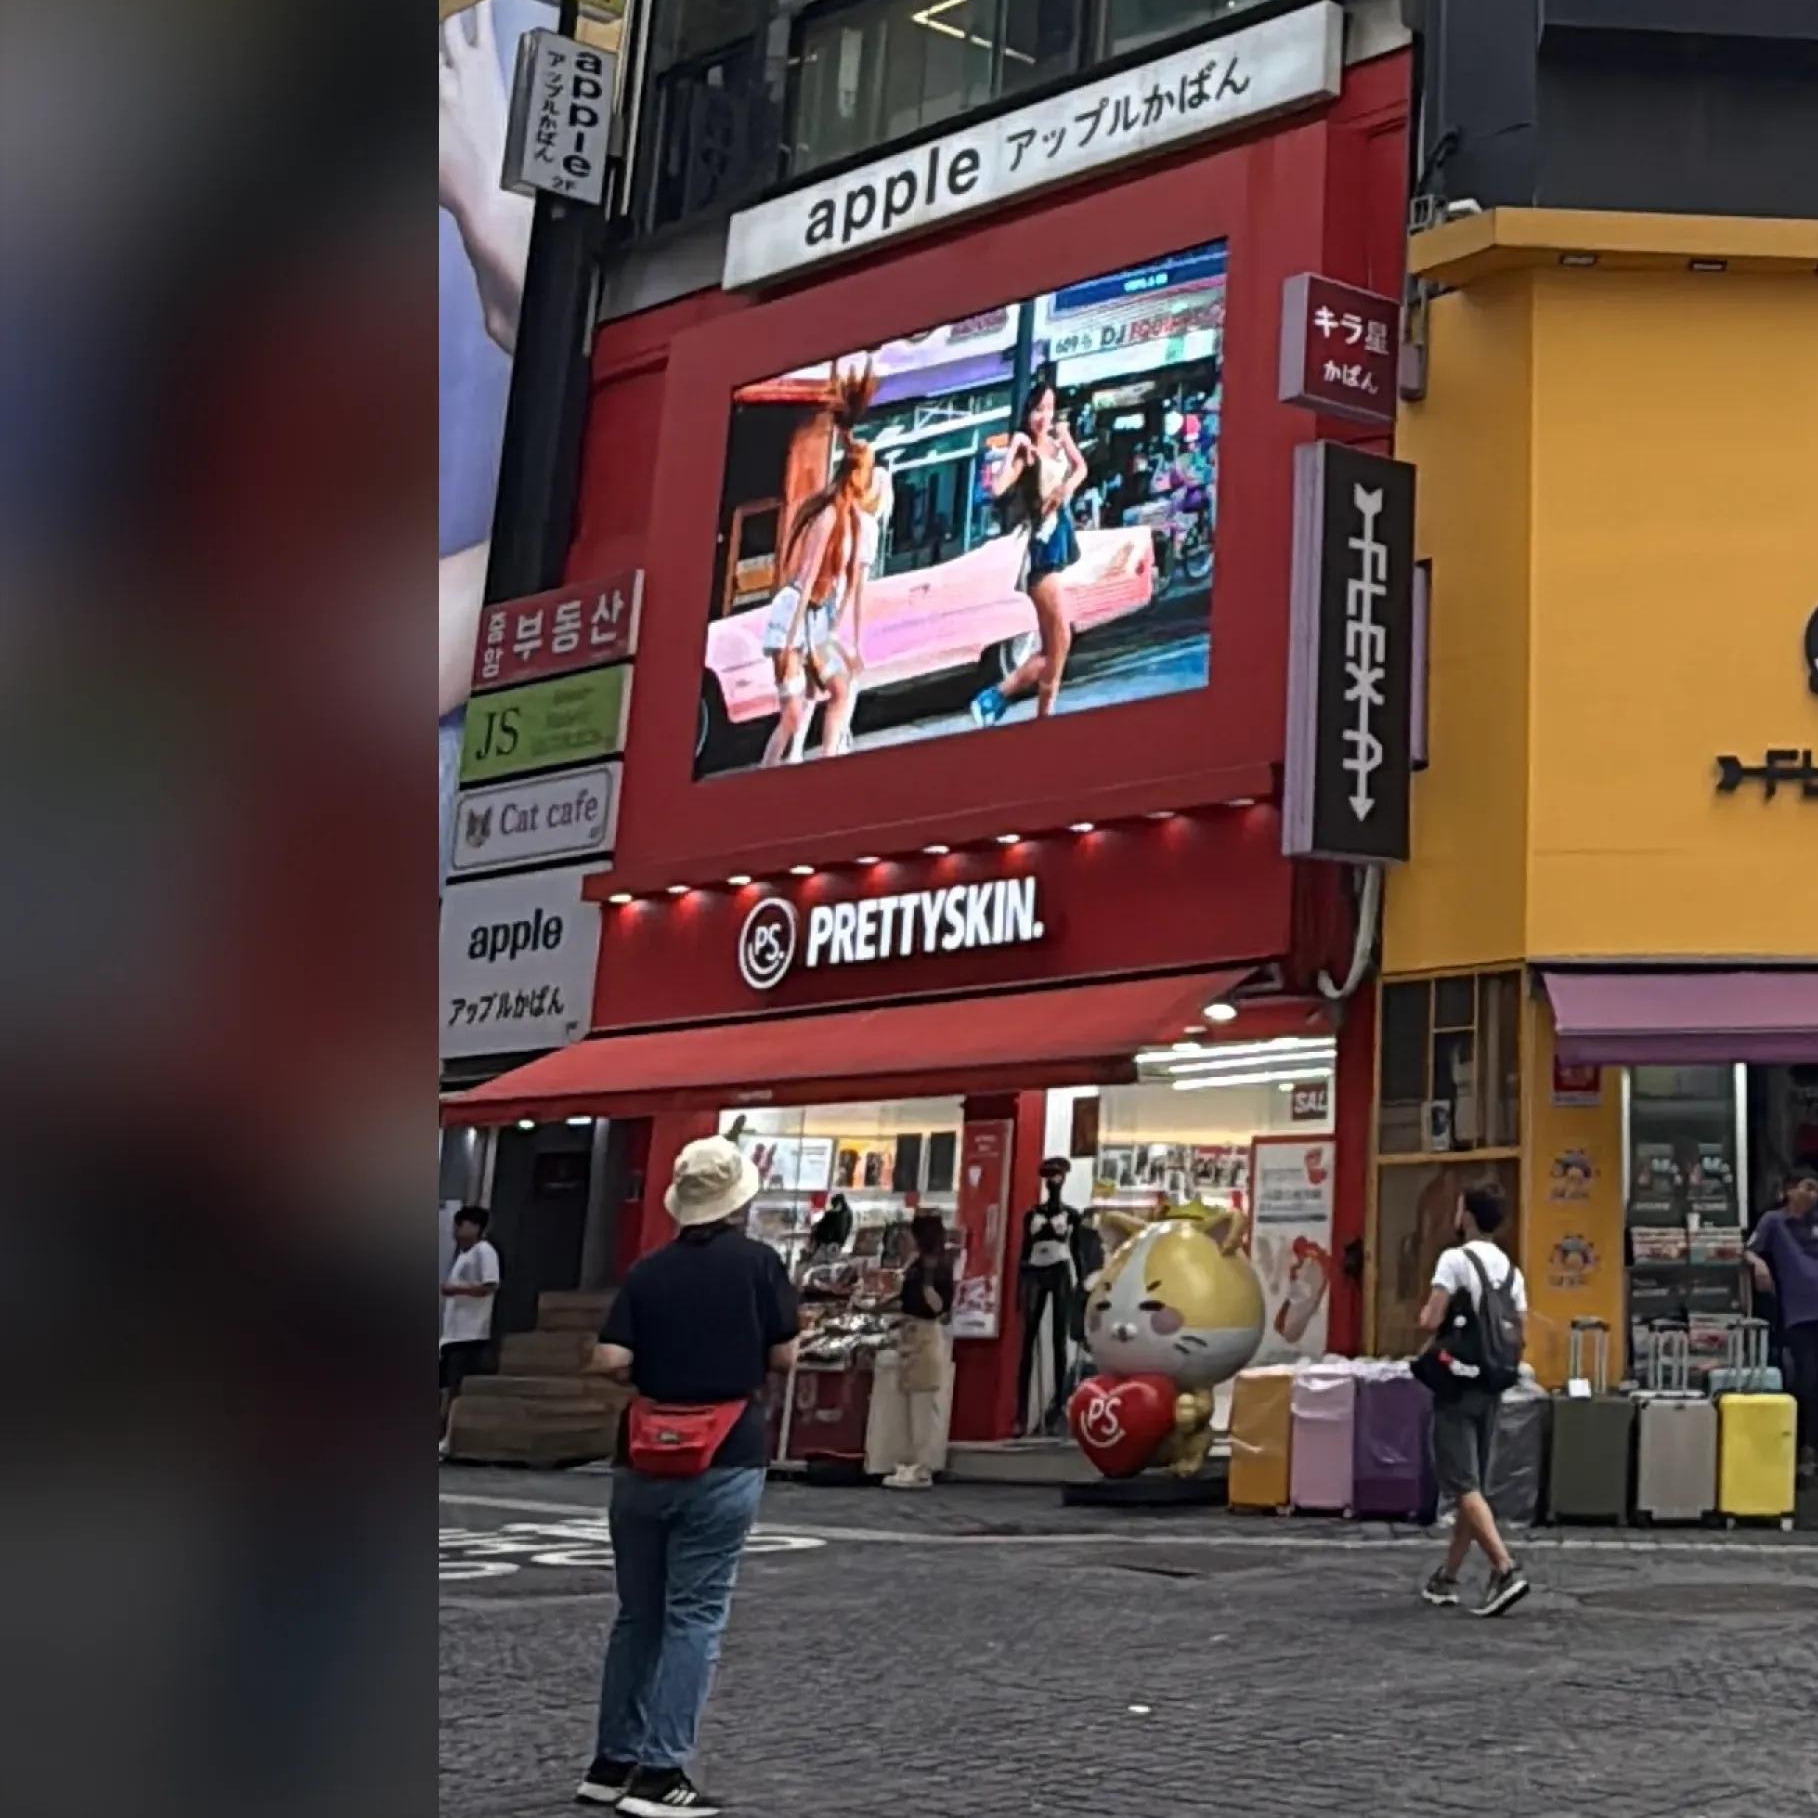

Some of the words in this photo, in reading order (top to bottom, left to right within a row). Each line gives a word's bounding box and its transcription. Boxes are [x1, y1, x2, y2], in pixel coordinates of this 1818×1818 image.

[562, 50, 603, 179] apple
[804, 144, 981, 248] apple
[1007, 55, 1251, 172] アップルかばん
[1313, 304, 1391, 358] キラ星
[1322, 358, 1380, 395] かばん
[513, 589, 625, 663] 부동산
[475, 706, 521, 762] JS
[500, 802, 540, 836] Cat
[545, 787, 600, 829] cafe
[467, 907, 564, 965] apple
